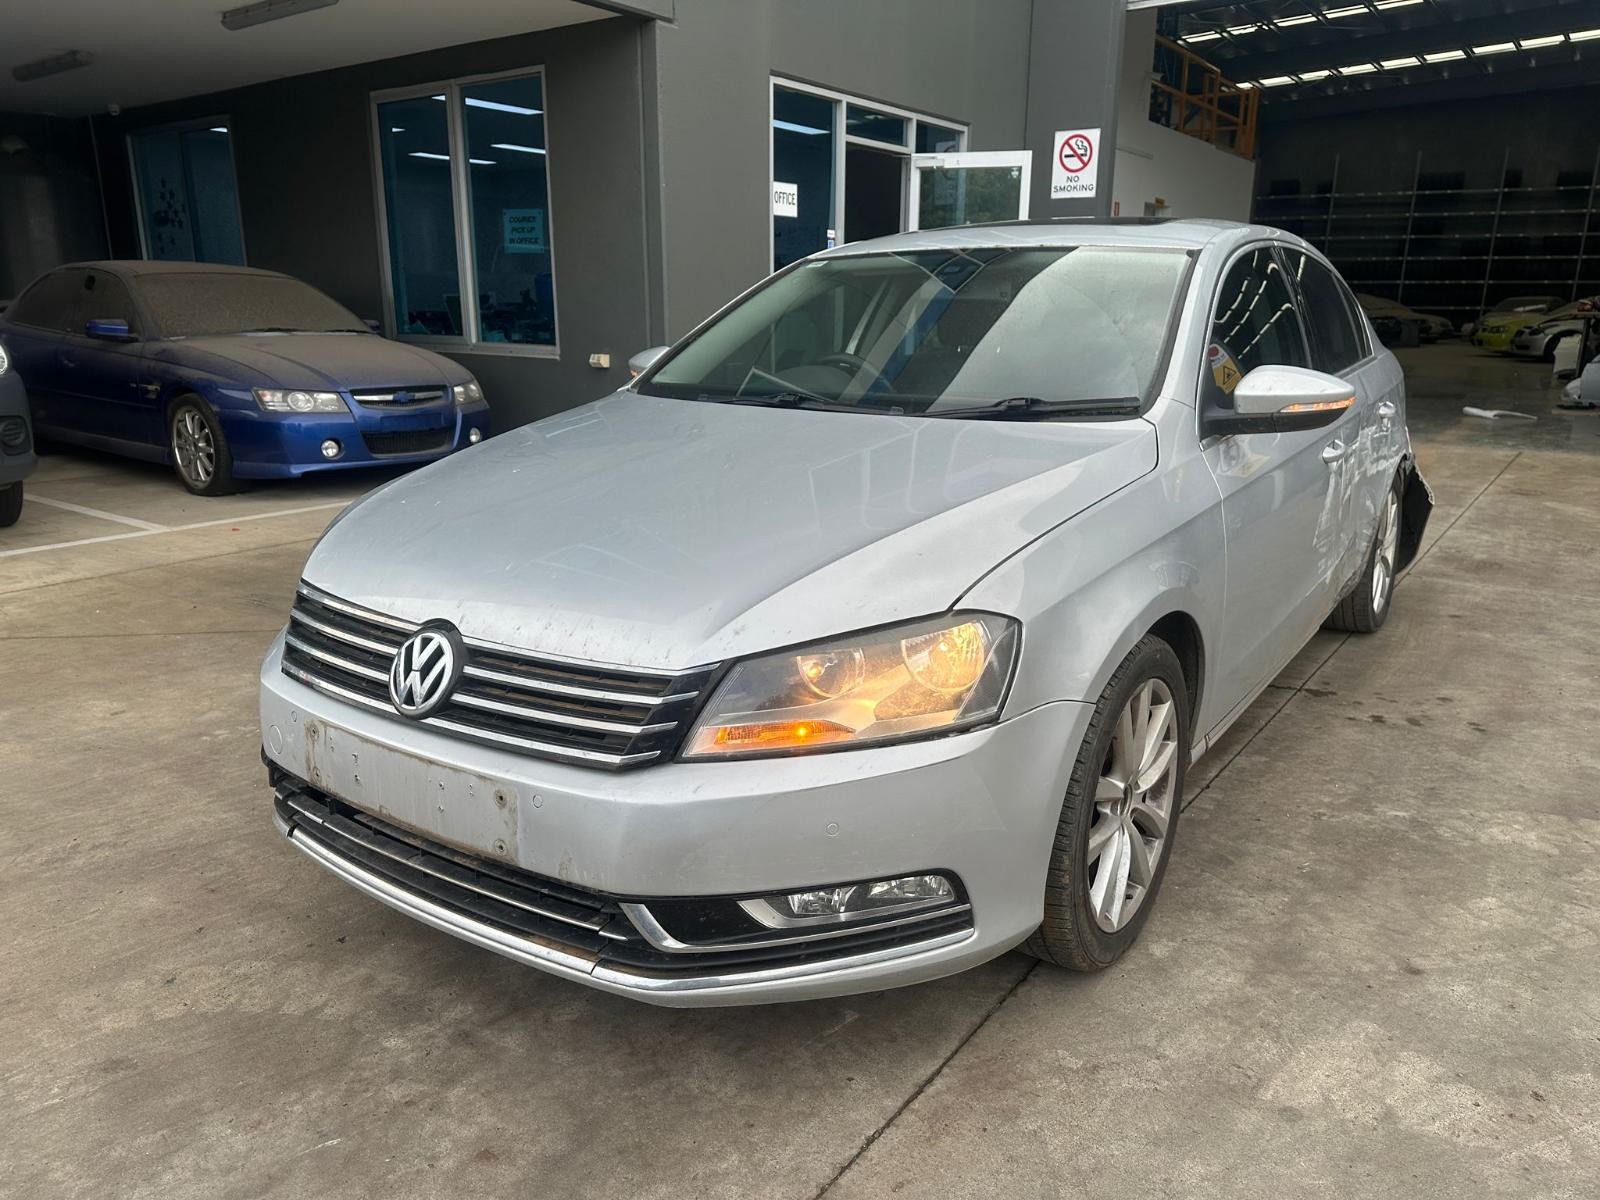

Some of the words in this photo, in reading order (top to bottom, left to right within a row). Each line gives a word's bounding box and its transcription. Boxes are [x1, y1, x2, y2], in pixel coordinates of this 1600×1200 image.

[1066, 175, 1080, 183] NO
[1053, 184, 1094, 193] SMOKING
[774, 191, 796, 205] OFFICE
